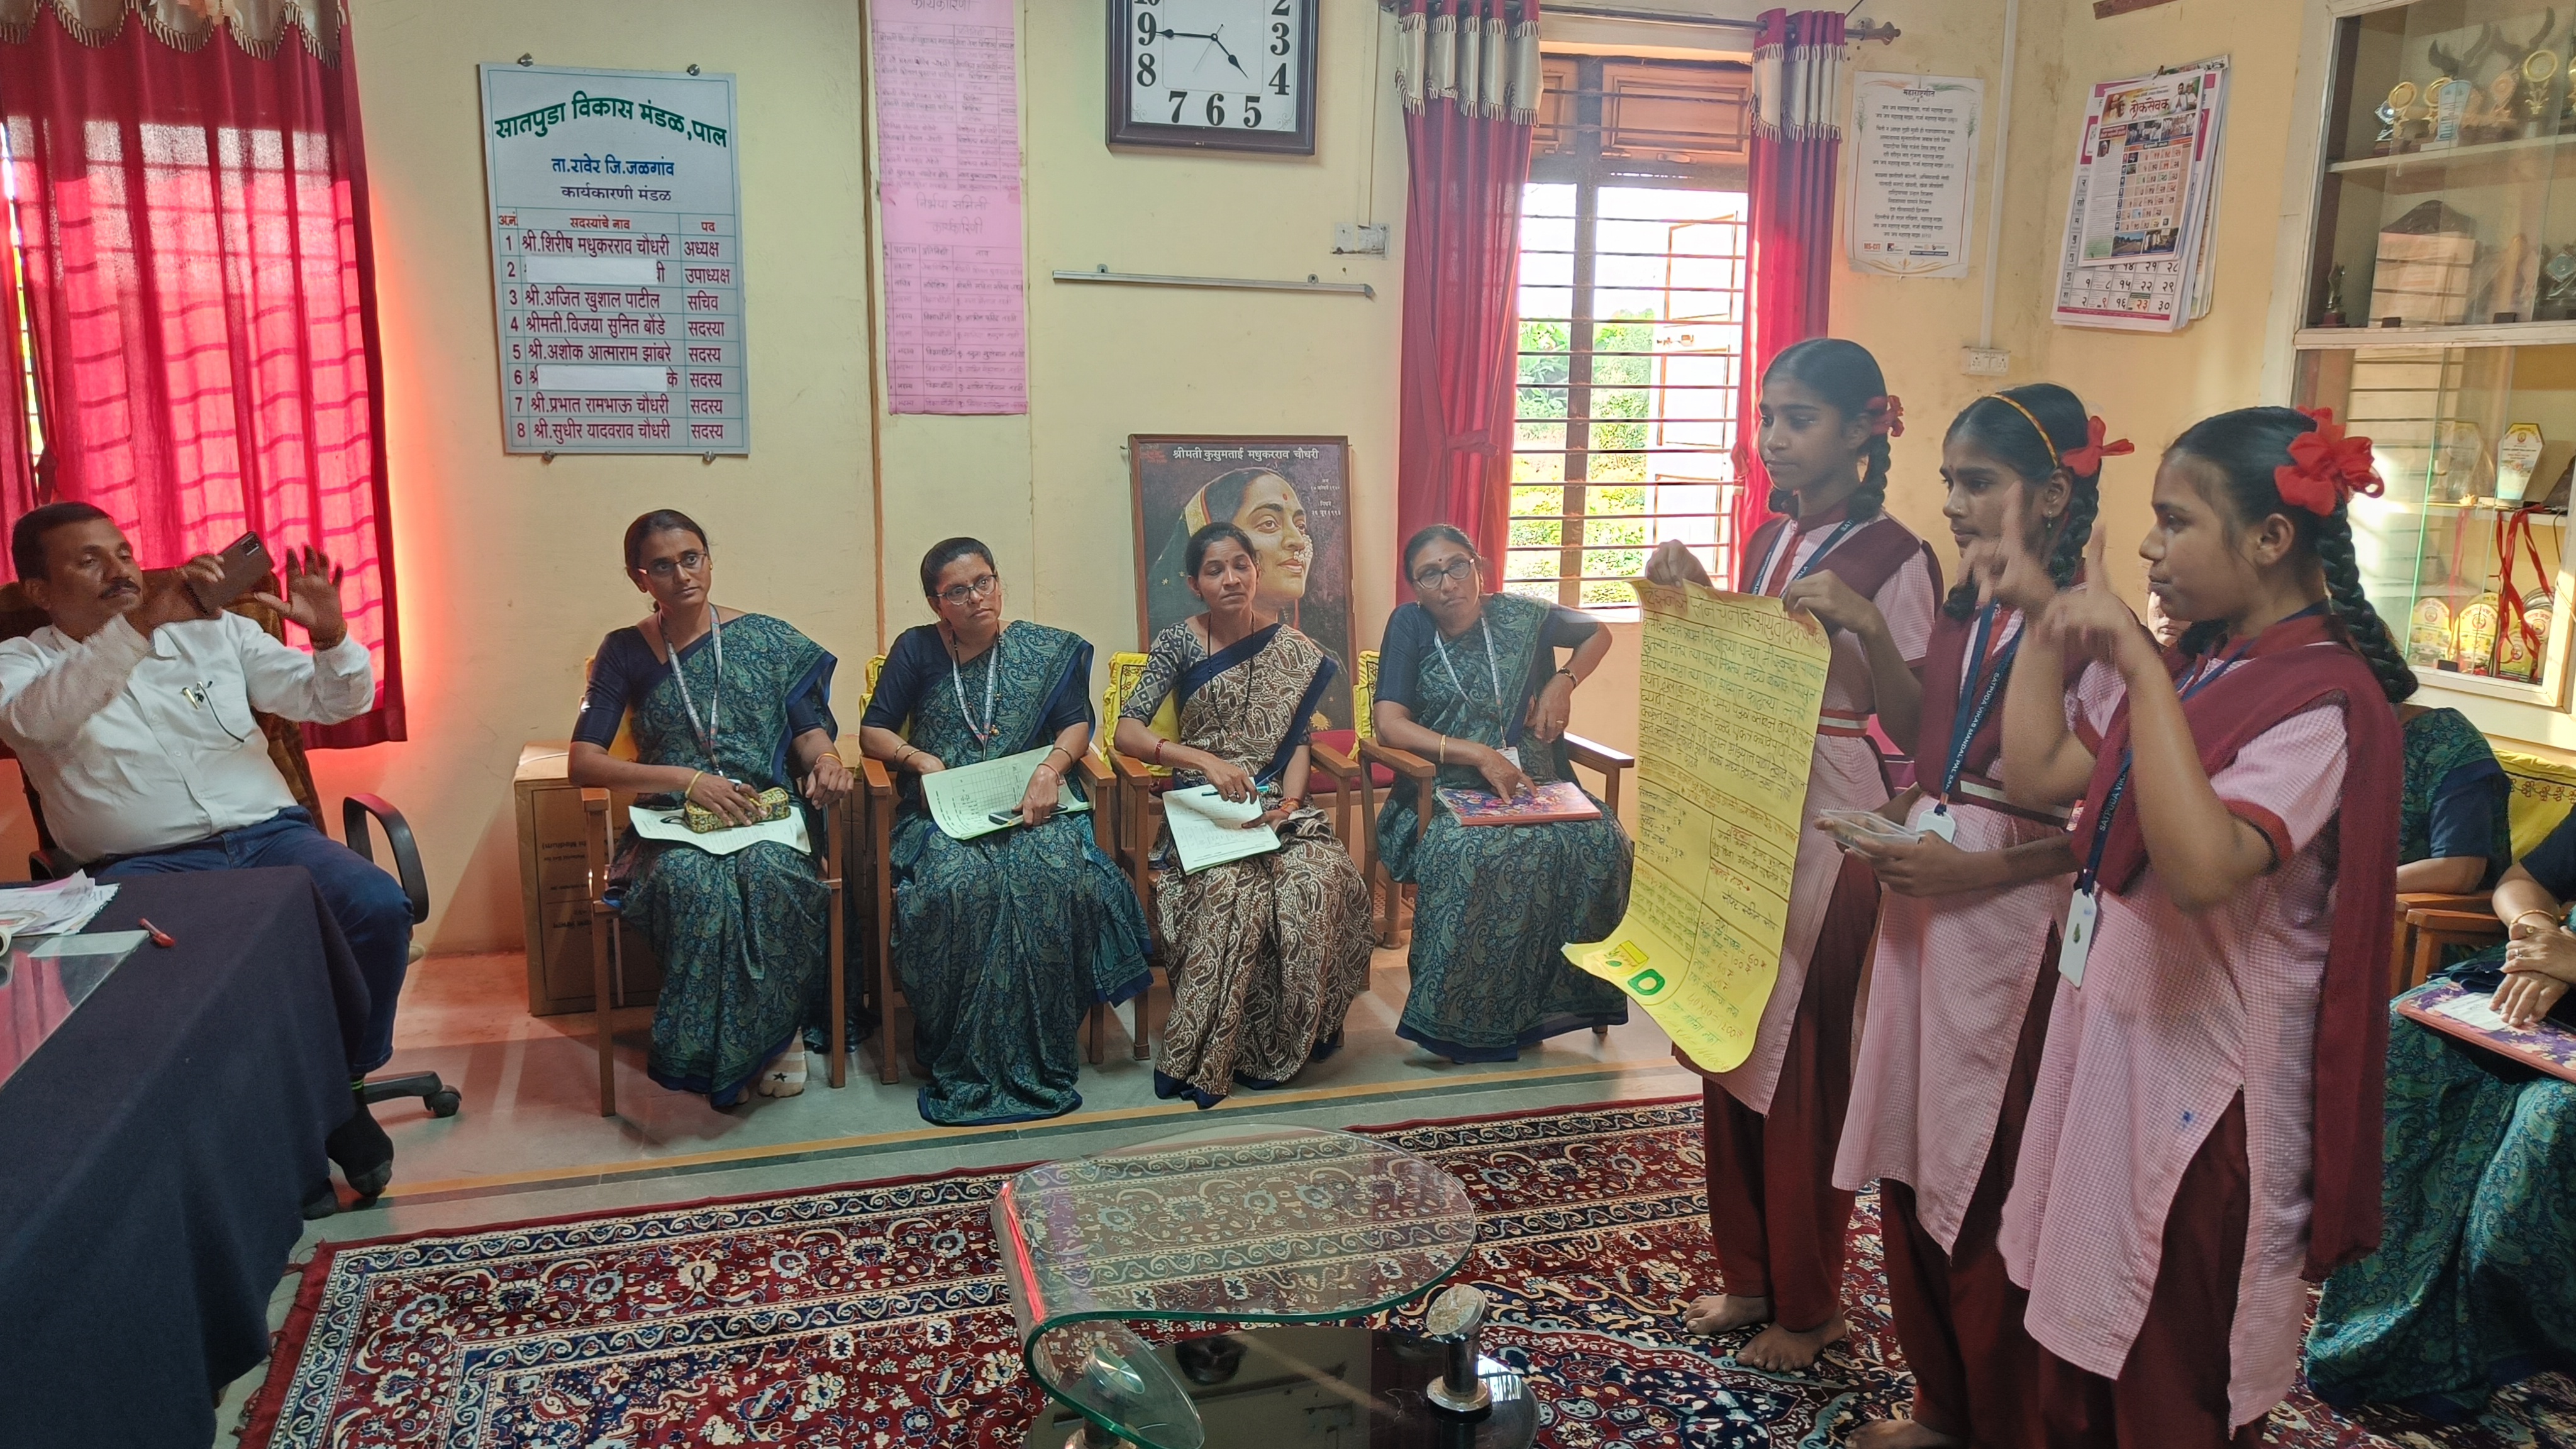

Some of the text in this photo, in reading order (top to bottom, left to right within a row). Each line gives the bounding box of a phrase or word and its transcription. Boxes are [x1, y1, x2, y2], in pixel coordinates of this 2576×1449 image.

[1138, 12, 1157, 46] 9
[1270, 22, 1290, 55] 3
[1136, 53, 1156, 87] 8
[1268, 63, 1290, 95] 4
[495, 101, 566, 138] सातपुडा
[572, 91, 633, 119] विकास
[1169, 91, 1187, 123] 7
[1206, 93, 1224, 126] 6
[1243, 95, 1262, 128] 5
[552, 153, 674, 175] ता.रावेर जि.जळगांव
[560, 182, 671, 201] कार्यकारणी मंडळ
[570, 214, 609, 229] सदस्यांचे
[612, 219, 630, 230] नाव
[701, 222, 716, 232] पद
[506, 230, 719, 257] 1 श्री.शिरीष मधुकरराव चौधरी अध्यक्ष
[507, 262, 515, 277] 2
[685, 269, 730, 284] उपाध्यक्ष
[2141, 282, 2152, 291] २२
[509, 284, 718, 312] 3 श्री.अजित खुशाल पाटील सचिव
[2136, 299, 2148, 311] २३
[2158, 301, 2170, 311] ३०
[511, 311, 724, 338] 4 श्रीमती.विजया सुनित बोंडे सदस्या
[513, 338, 721, 362] 5 श्री.अशोक आत्माराम झांबरे सदस्य
[514, 370, 522, 385] 6
[690, 373, 722, 388] सदस्य
[515, 392, 723, 414] 7 श्री.प्रभात रामभाऊ चौधरी सदस्य
[518, 418, 724, 444] 8 श्री.सुधीर यादवराव चौधरी सदस्य
[1173, 447, 1202, 460] श्रीमती
[1204, 447, 1244, 462] कुसुमताई
[1247, 450, 1290, 462] मधुकरराव
[1294, 447, 1319, 460] चौधरी
[1982, 672, 2001, 705] SATPUDA
[1957, 728, 1974, 759] MANDAL
[1951, 759, 1961, 775] PAL
